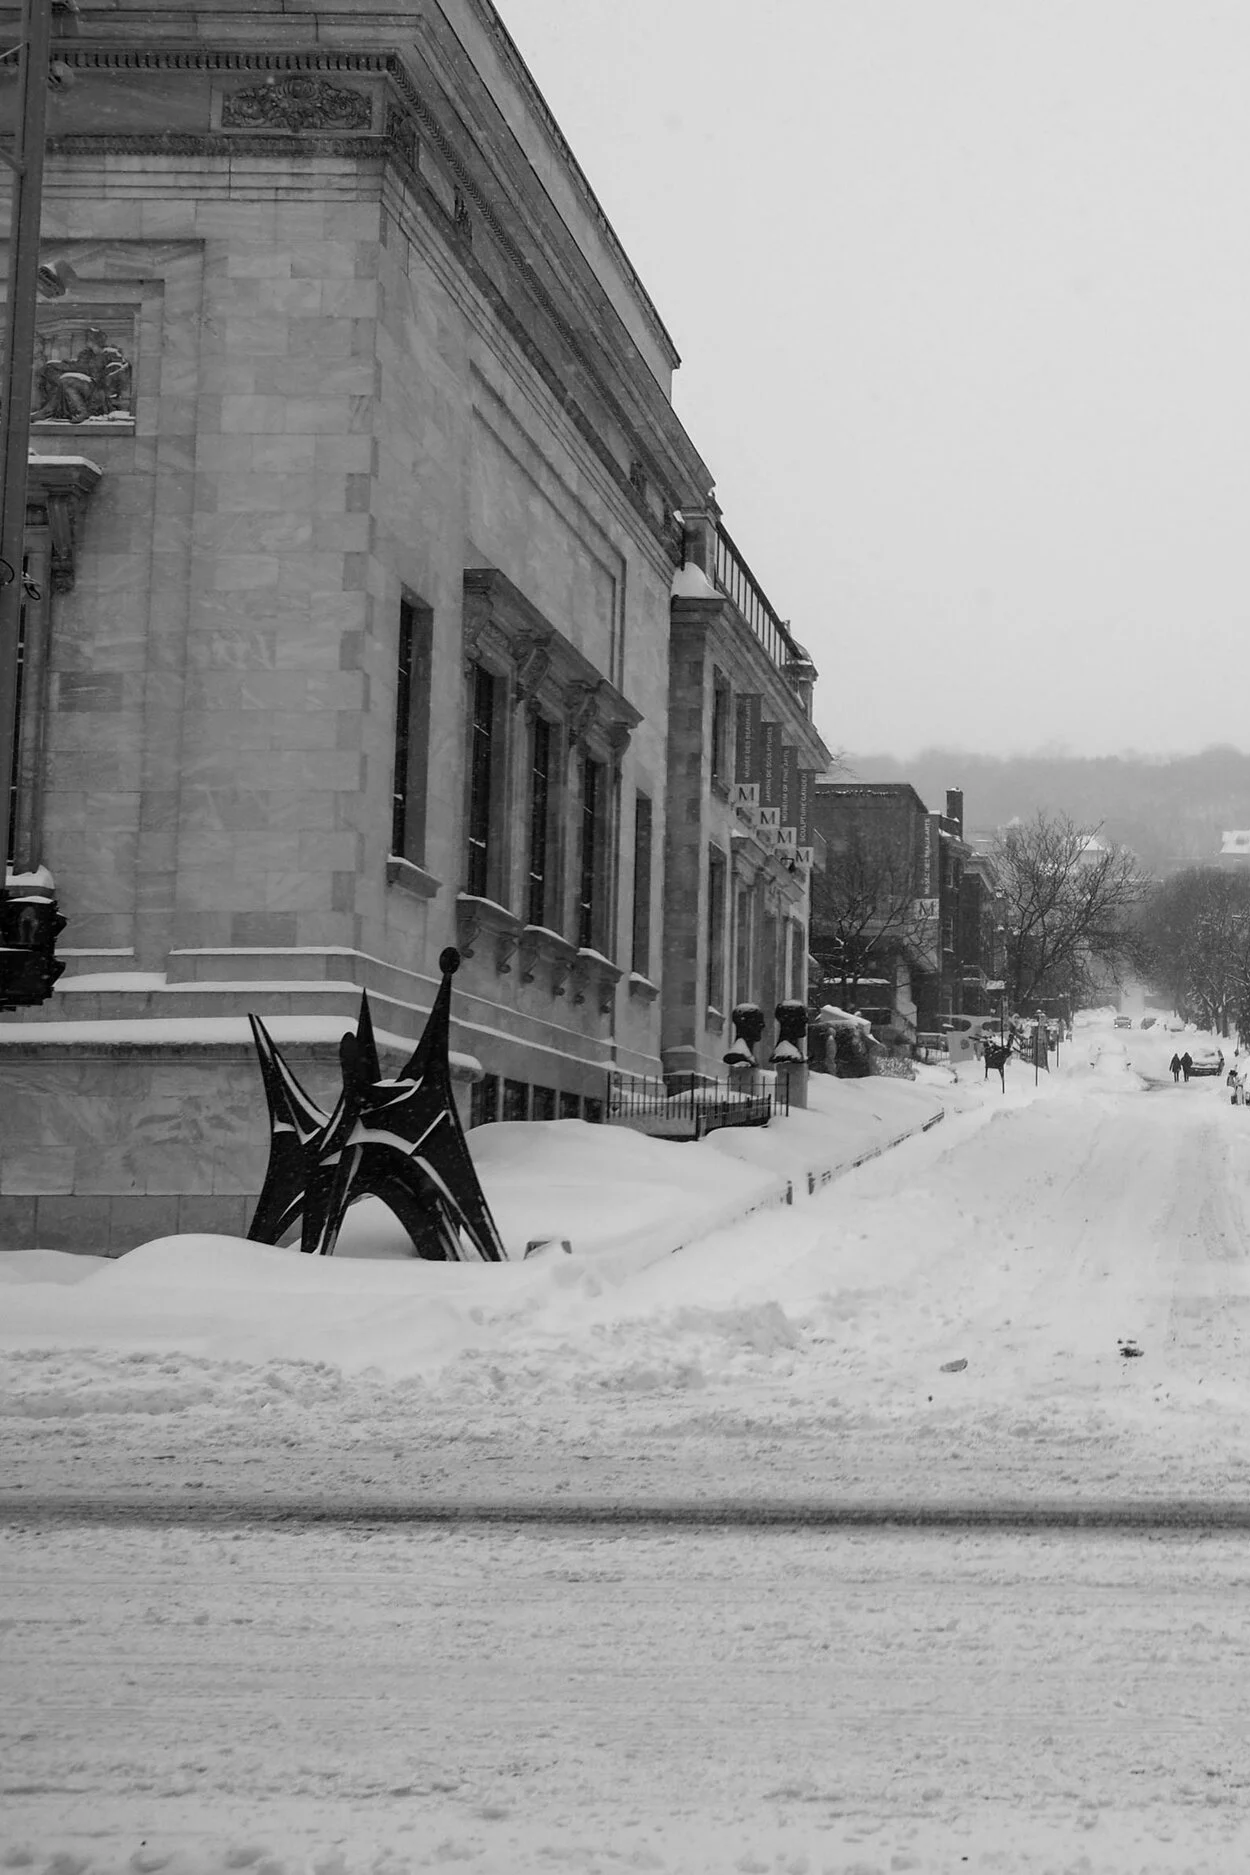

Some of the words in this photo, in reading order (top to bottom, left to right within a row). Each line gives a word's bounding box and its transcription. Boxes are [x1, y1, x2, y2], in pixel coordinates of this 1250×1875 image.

[739, 786, 755, 801] M
[760, 810, 776, 825] M
[777, 830, 792, 843] M
[796, 849, 809, 863] M
[919, 901, 935, 916] M
